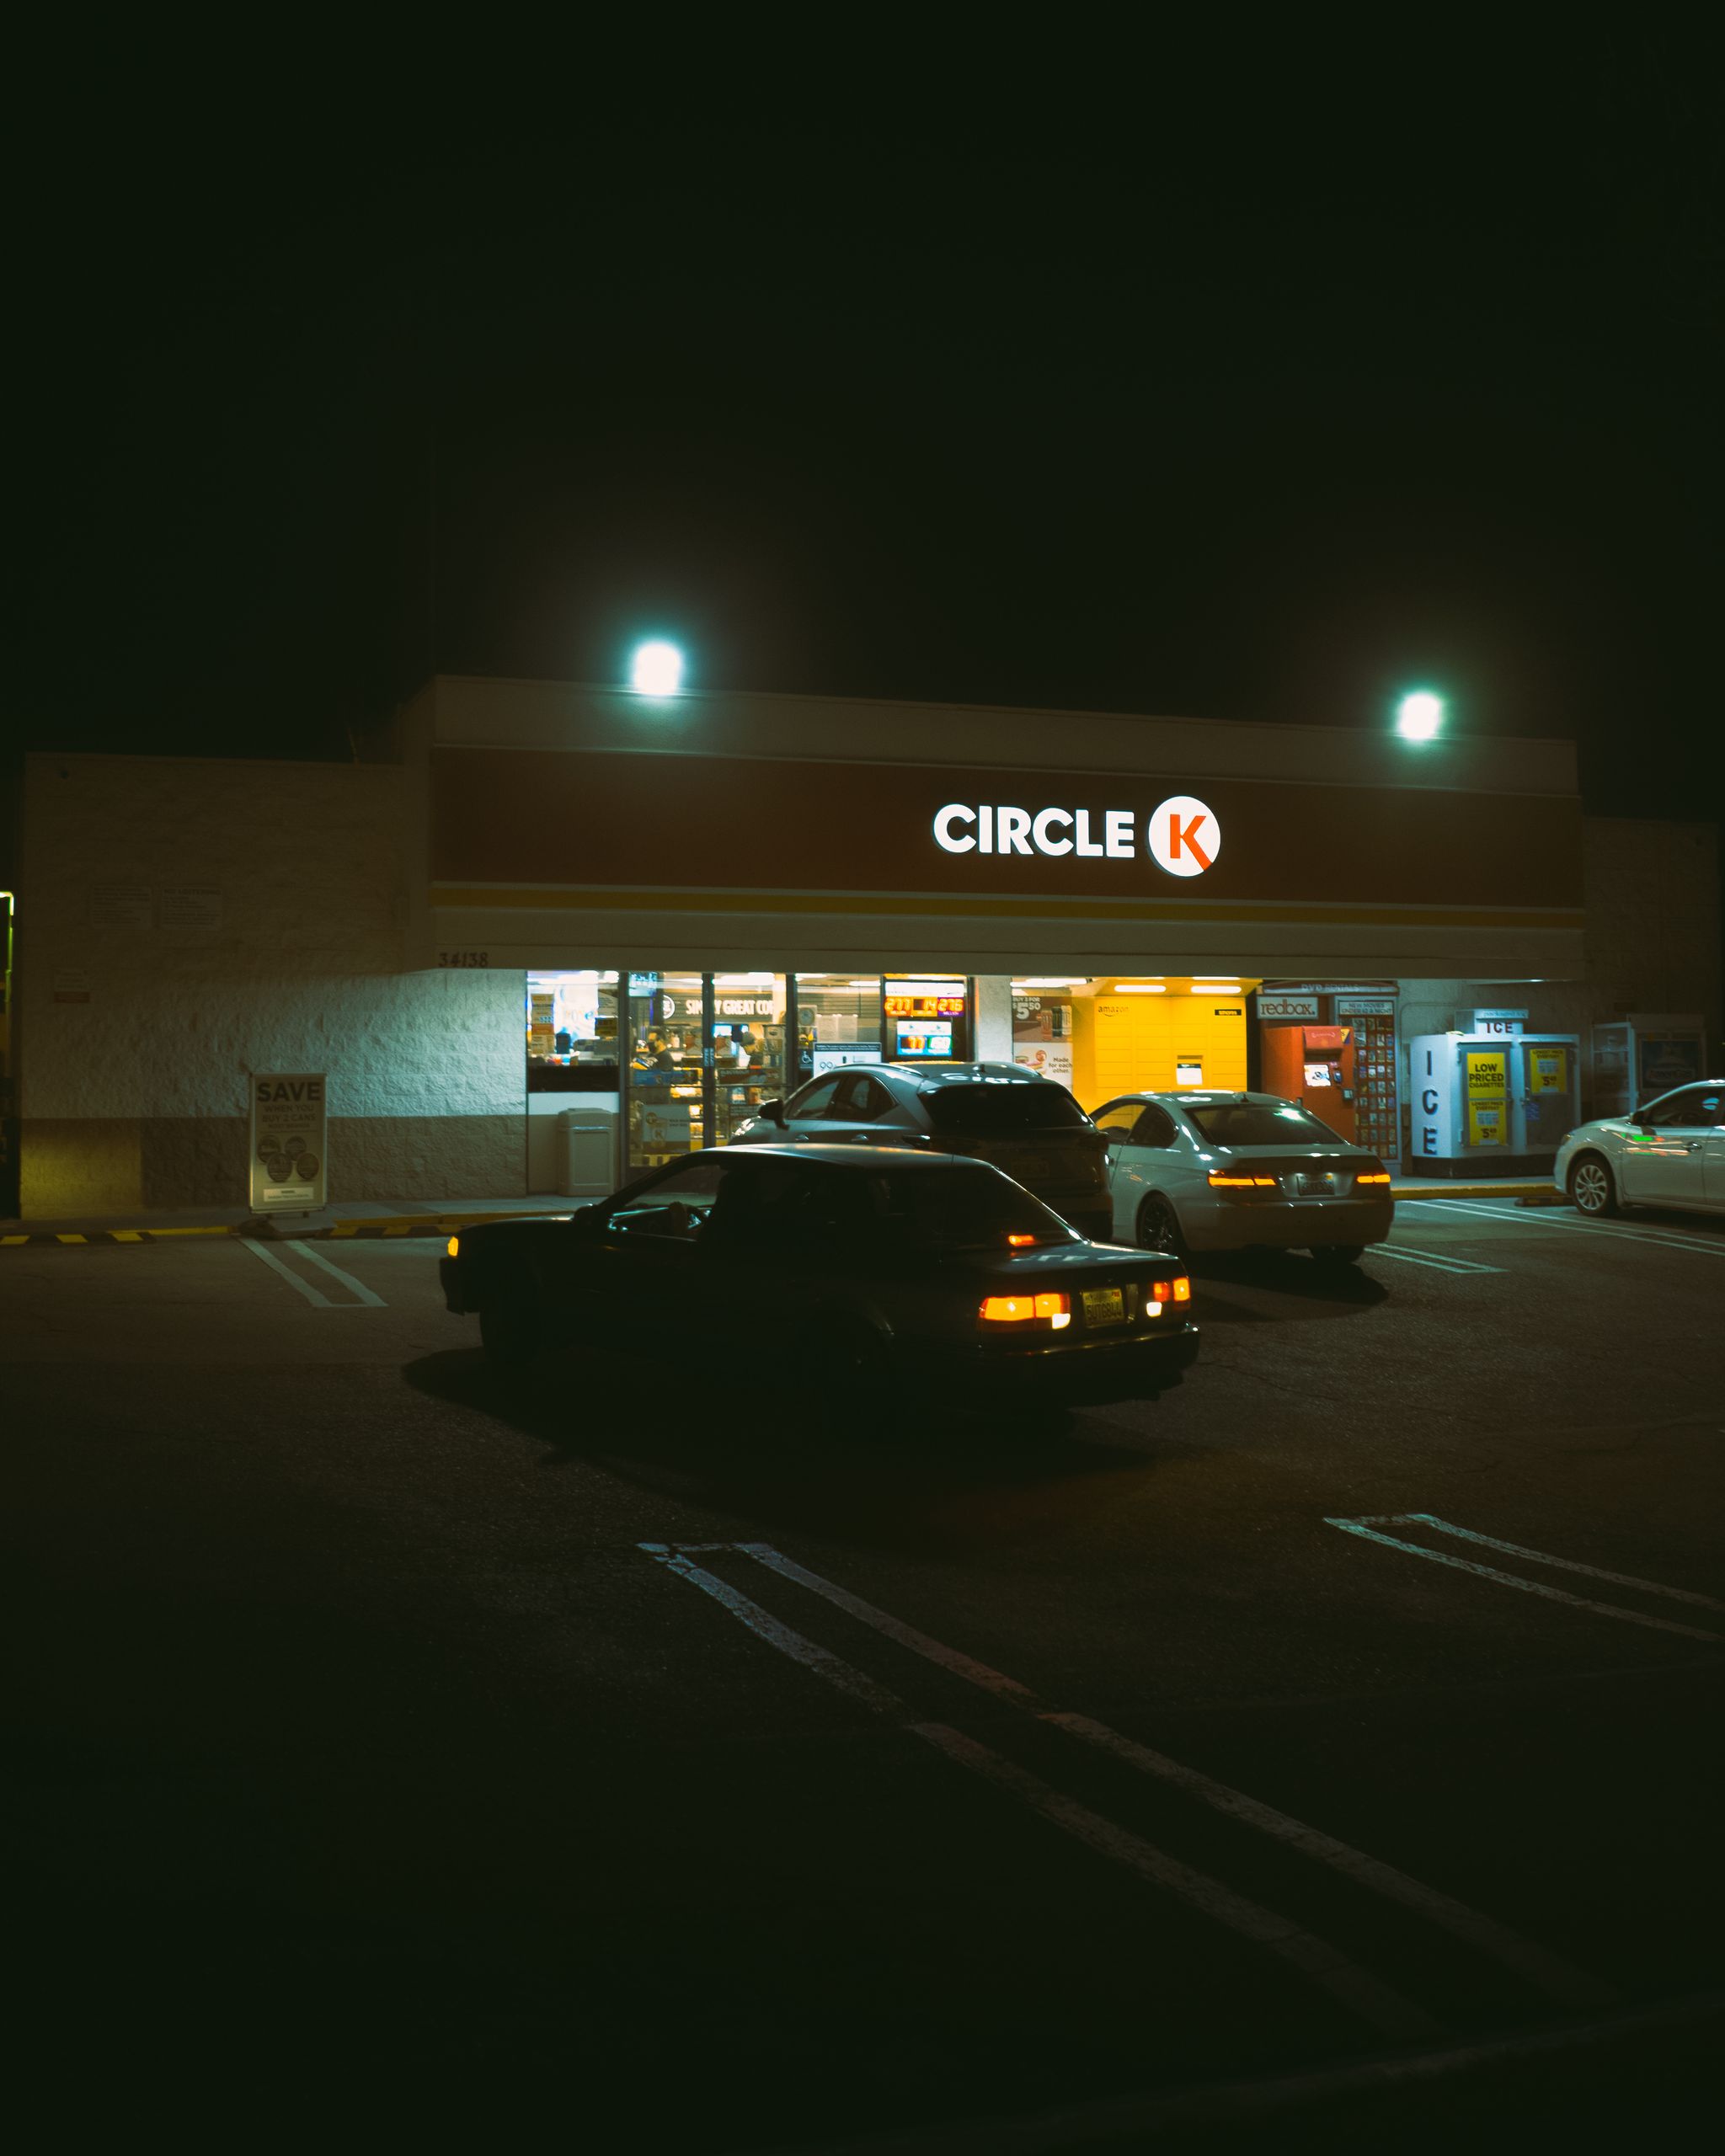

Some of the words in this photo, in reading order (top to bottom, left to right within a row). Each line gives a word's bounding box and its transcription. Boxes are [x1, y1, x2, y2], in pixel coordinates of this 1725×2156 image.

[933, 803, 1135, 858] CIRCLE
[1169, 814, 1211, 871] K
[438, 952, 489, 968] 34138
[884, 998, 911, 1011] 277
[1486, 1022, 1514, 1033] ICE
[1475, 1064, 1498, 1072] LOW
[257, 1082, 321, 1102] SAVE
[264, 1104, 292, 1113] WHEN
[294, 1103, 314, 1112] YOU
[1422, 1050, 1439, 1155] ICE
[263, 1114, 280, 1123] BUY
